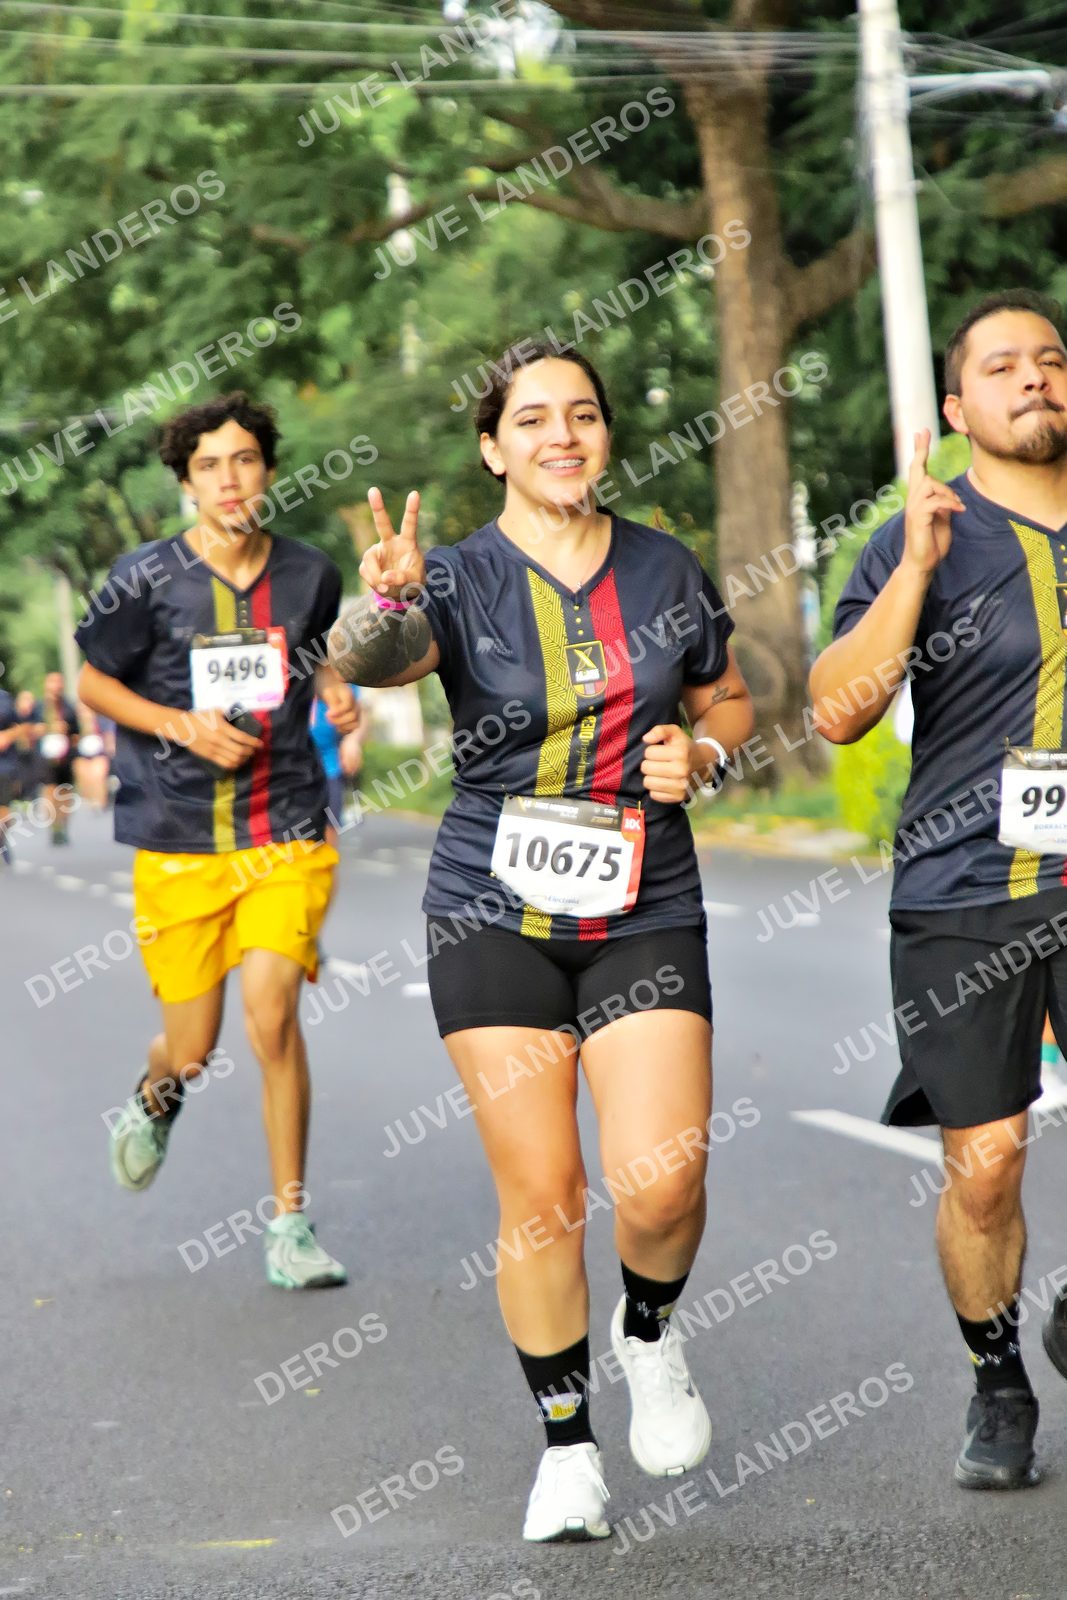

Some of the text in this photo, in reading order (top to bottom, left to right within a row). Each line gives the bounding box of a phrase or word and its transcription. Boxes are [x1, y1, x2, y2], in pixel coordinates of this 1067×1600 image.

[207, 654, 267, 684] 9496
[1021, 784, 1066, 817] 99
[506, 832, 622, 882] 10675
